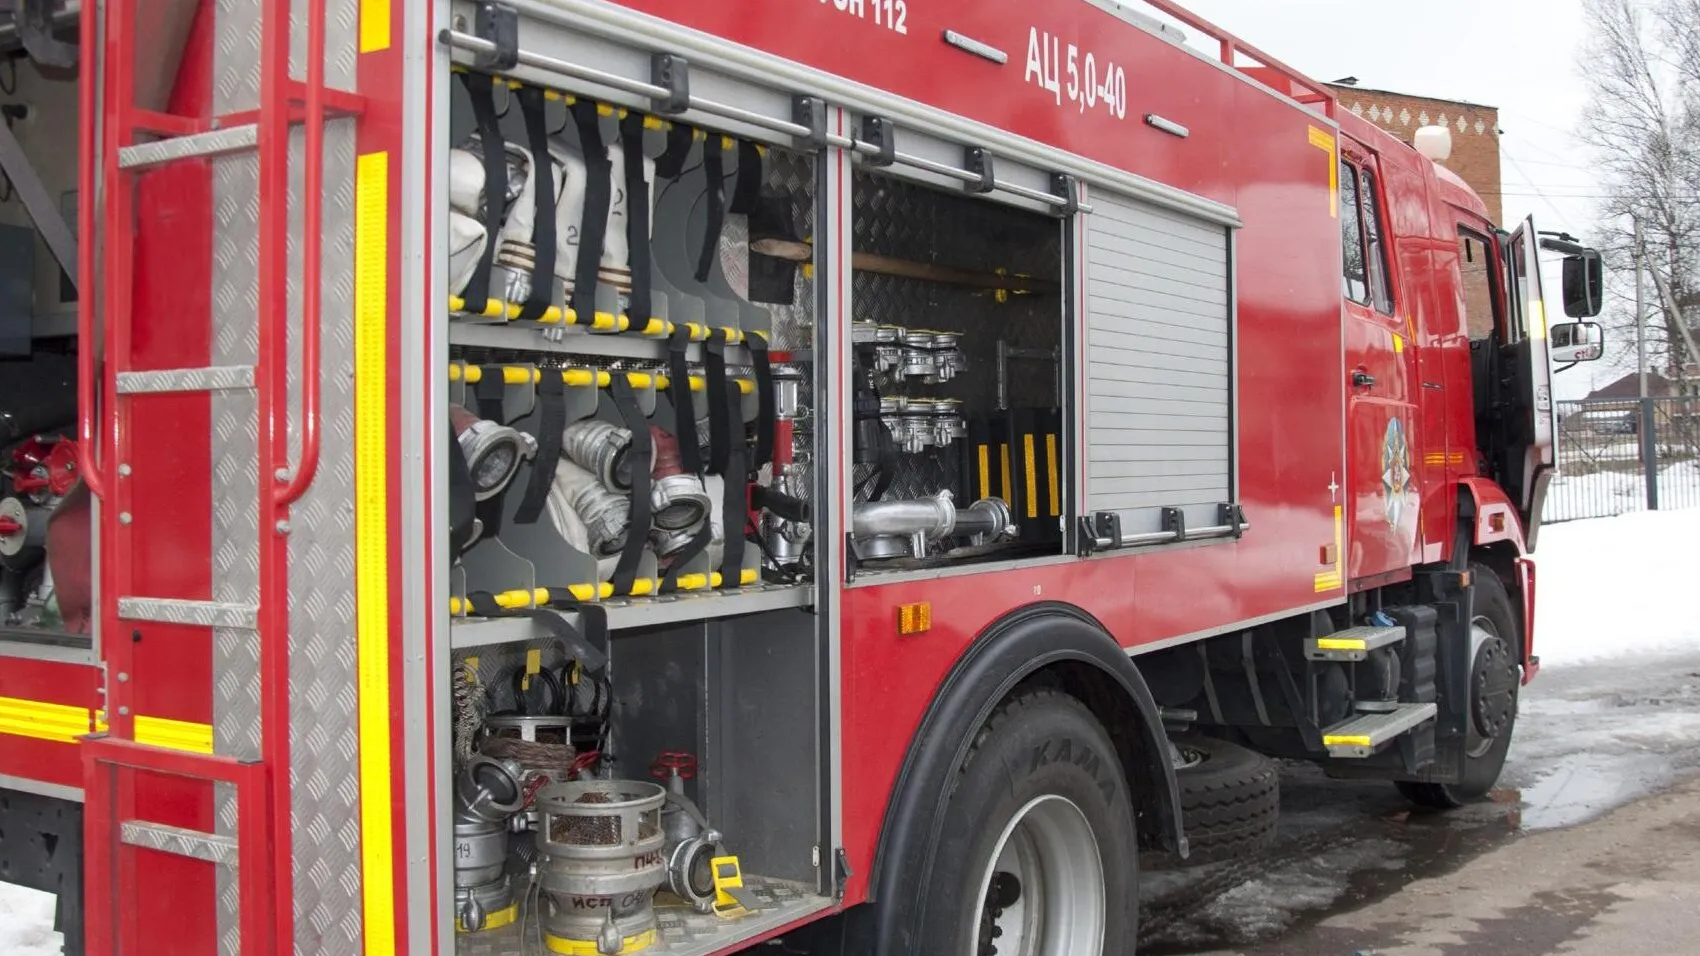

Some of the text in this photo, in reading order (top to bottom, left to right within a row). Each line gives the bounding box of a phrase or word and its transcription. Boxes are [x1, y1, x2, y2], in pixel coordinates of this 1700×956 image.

[871, 0, 908, 35] 112
[1024, 26, 1127, 121] АЦ 5,0-40
[566, 225, 579, 246] 2
[456, 842, 471, 858] 19
